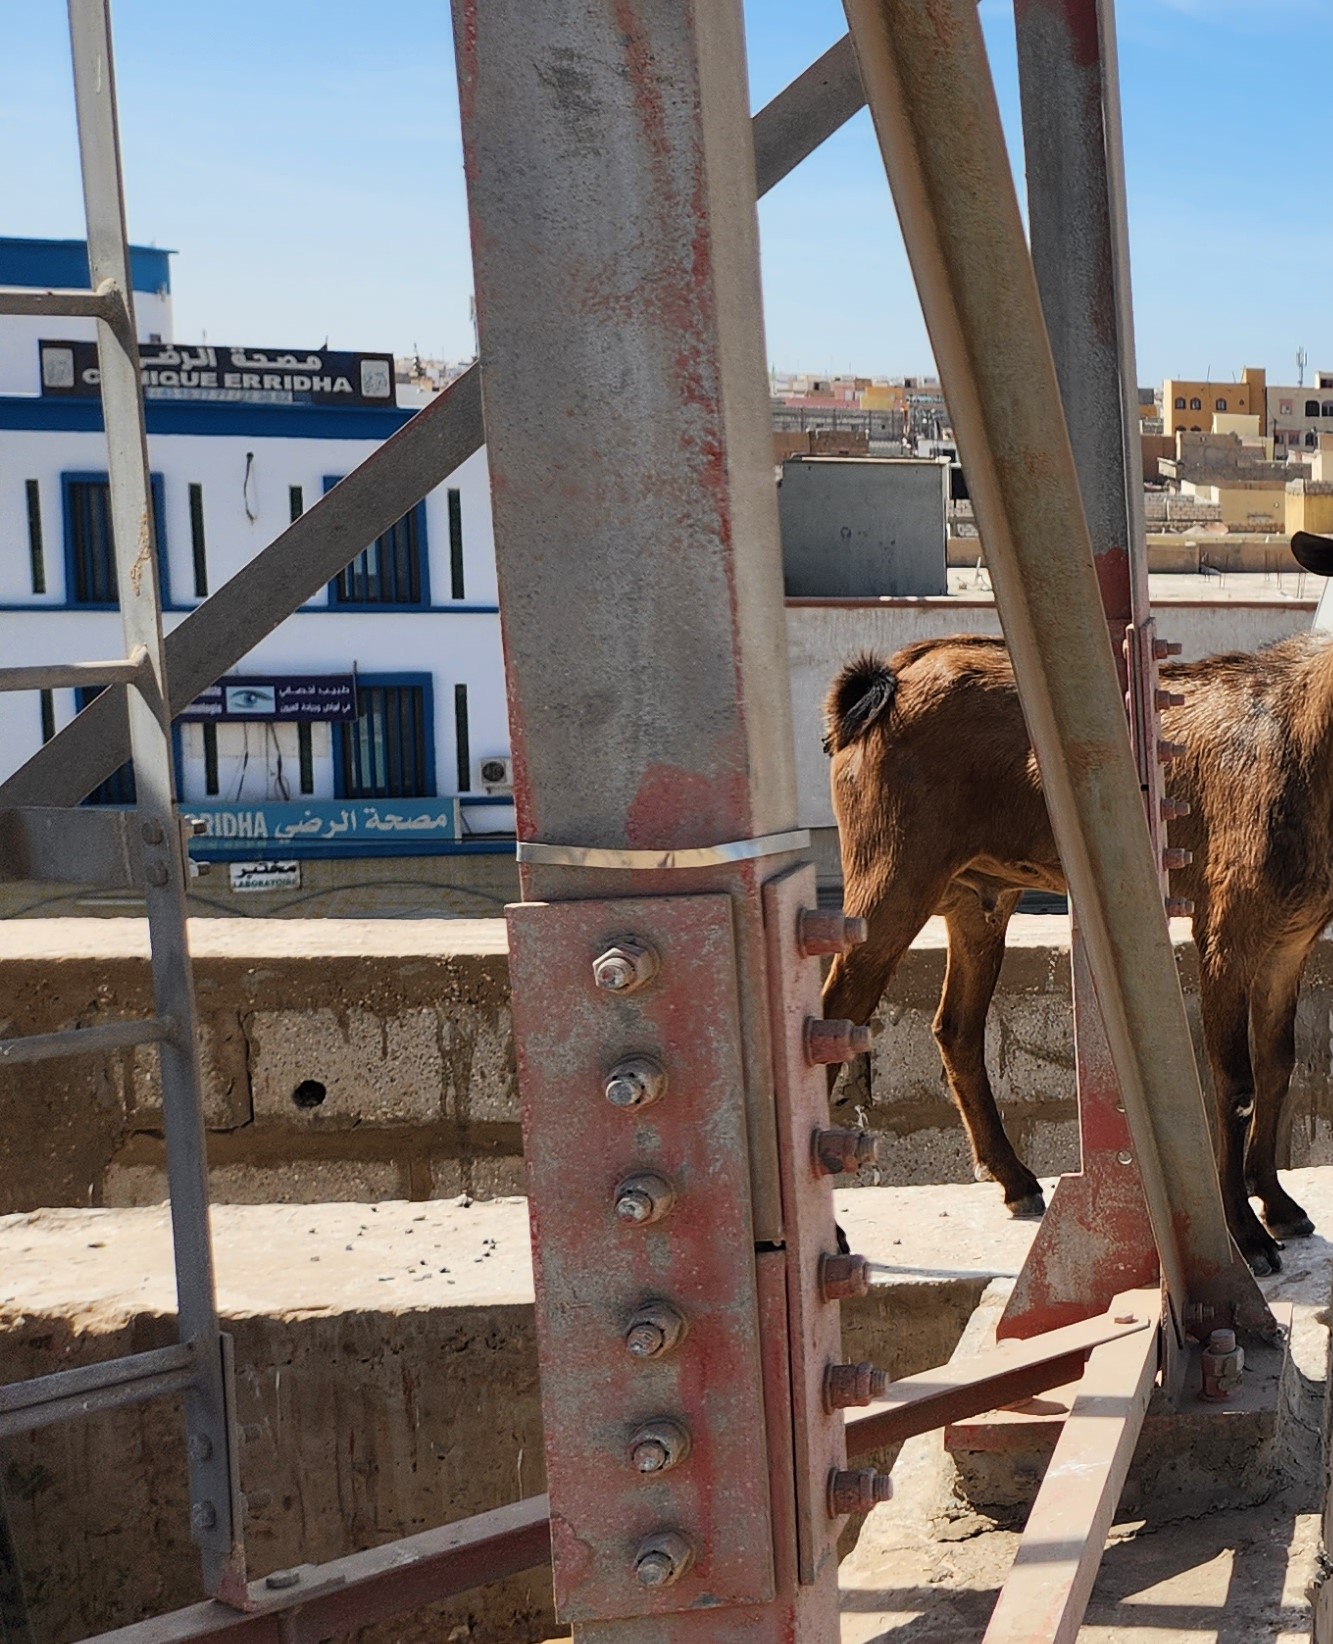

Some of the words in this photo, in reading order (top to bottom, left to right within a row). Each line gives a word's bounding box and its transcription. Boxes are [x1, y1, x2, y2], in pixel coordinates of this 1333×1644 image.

[139, 344, 218, 370] الرض
[231, 346, 322, 371] مصحة
[224, 372, 353, 393] ERRIDHA
[274, 808, 357, 844] الرضي
[364, 807, 448, 831] مصحة
[234, 861, 297, 879] مختبر
